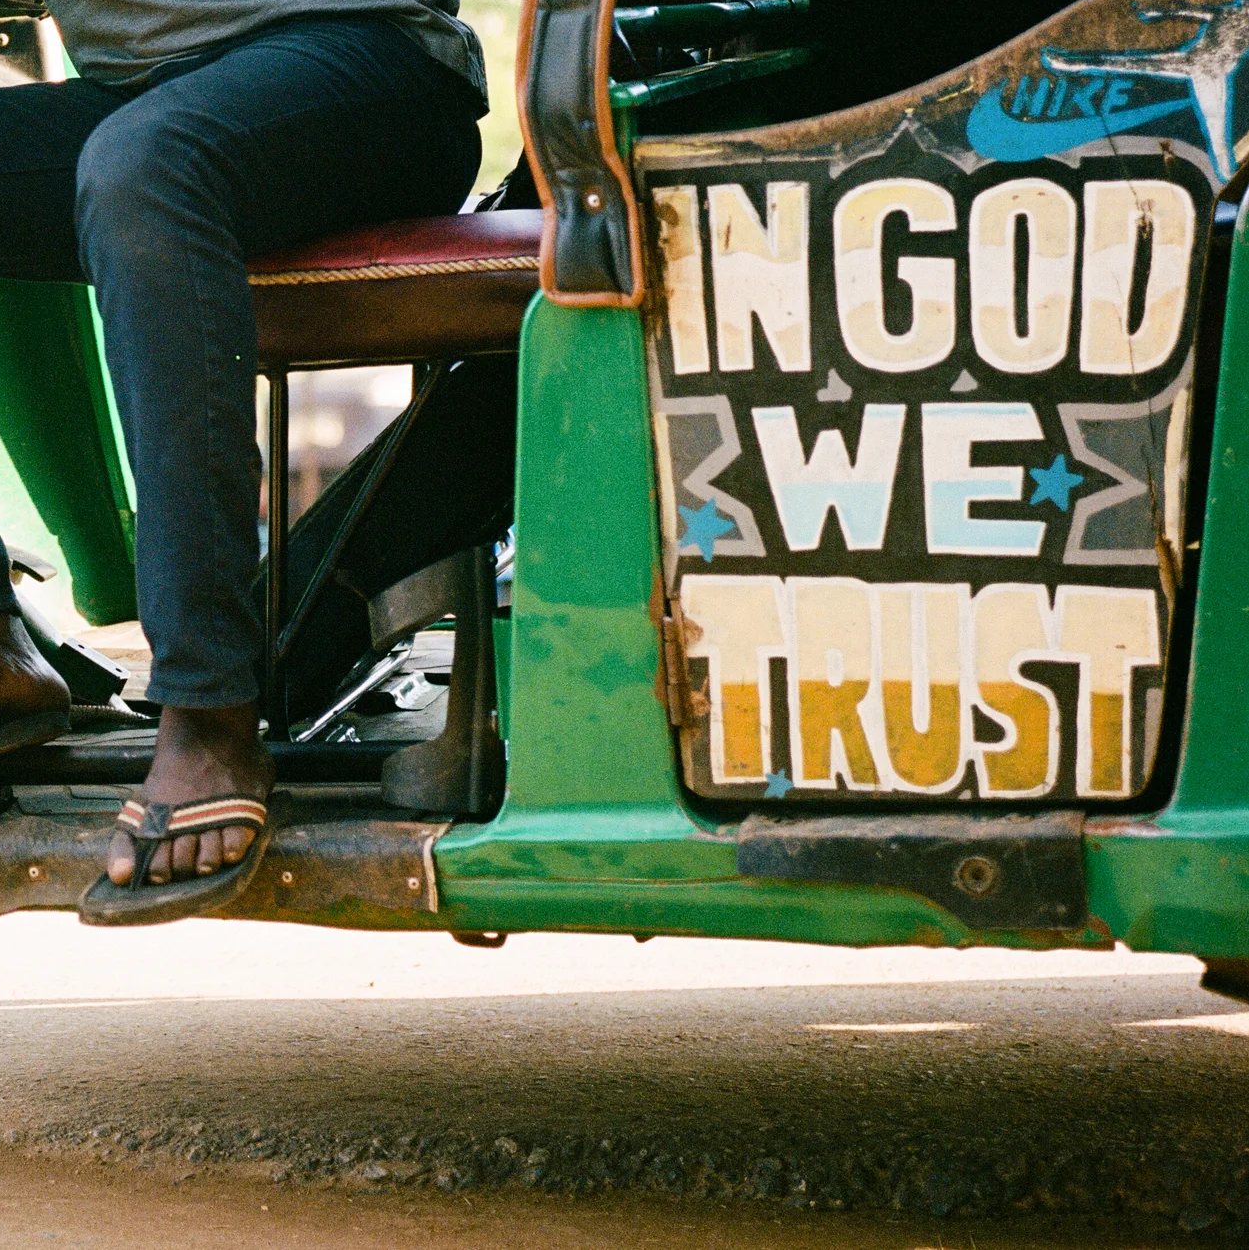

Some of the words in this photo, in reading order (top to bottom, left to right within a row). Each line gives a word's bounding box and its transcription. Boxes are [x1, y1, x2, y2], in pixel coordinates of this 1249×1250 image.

[1010, 75, 1133, 117] NIKE
[652, 182, 812, 374] IN
[833, 177, 1196, 375] GOD
[752, 402, 1047, 557] WE
[681, 575, 1161, 799] TRUST
